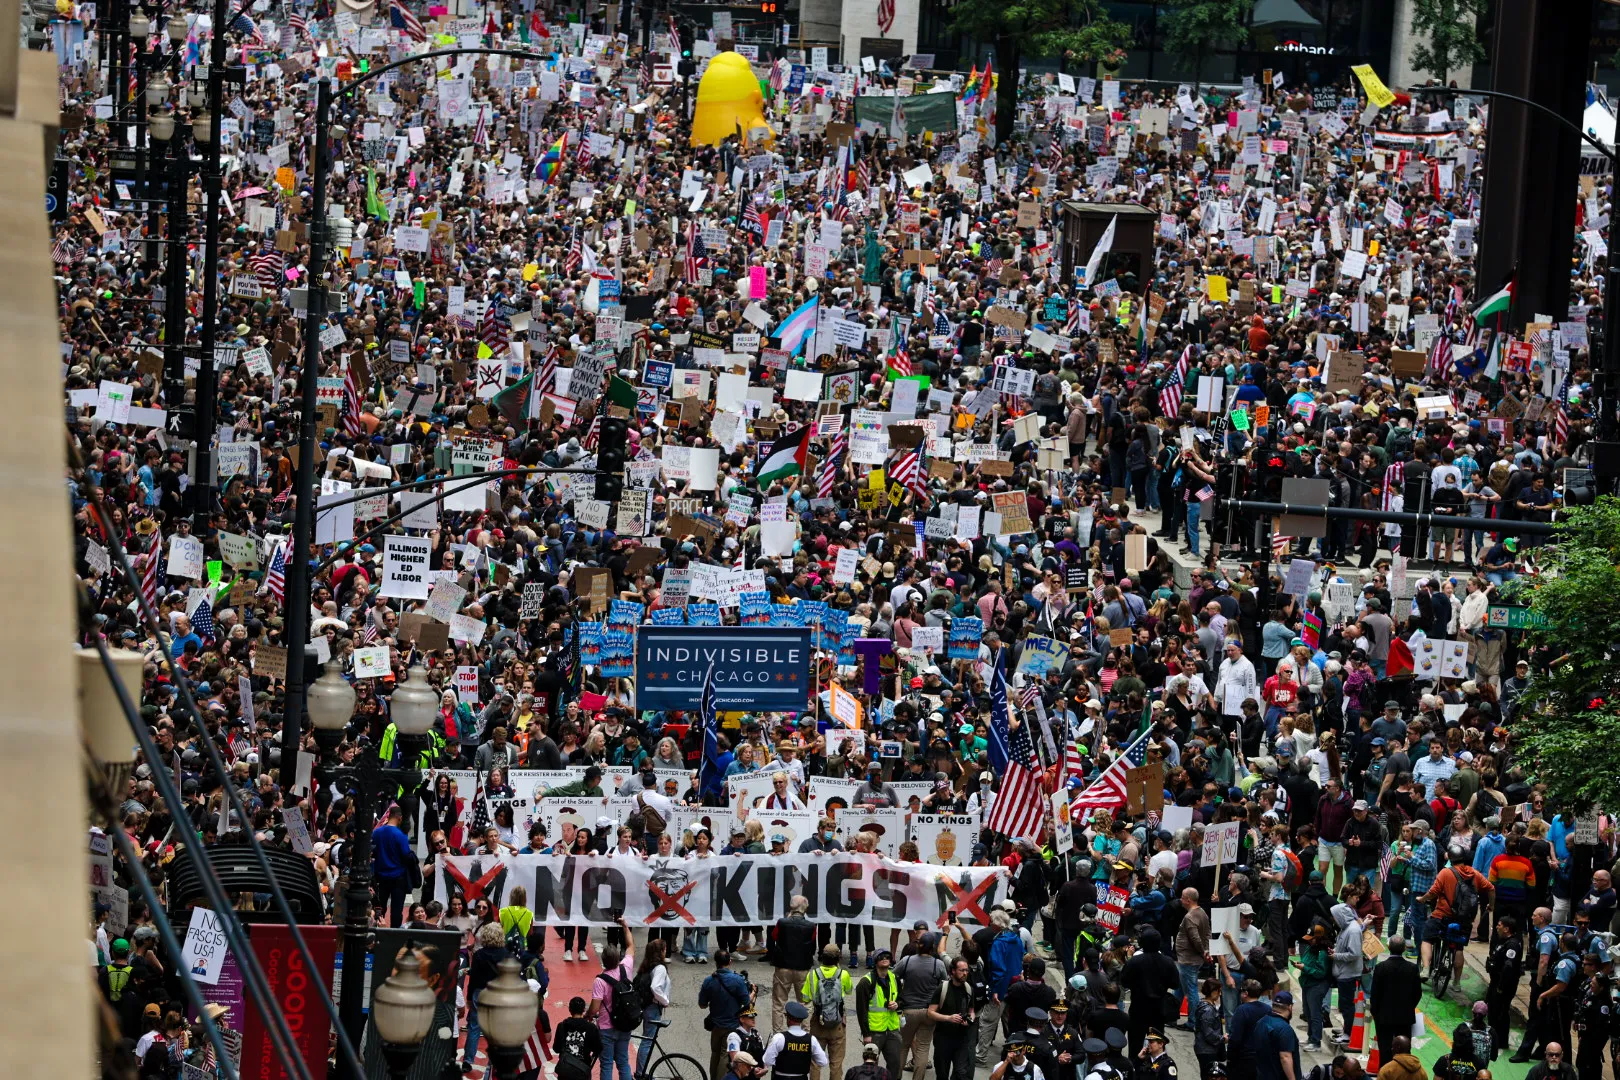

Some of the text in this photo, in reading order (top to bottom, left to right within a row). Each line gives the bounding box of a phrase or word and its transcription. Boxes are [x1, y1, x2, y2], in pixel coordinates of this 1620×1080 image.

[740, 219, 762, 234] AME
[237, 281, 258, 290] YOU'RE
[238, 288, 258, 298] FIRED!
[576, 354, 604, 370] IMPEACH
[656, 366, 670, 374] KINGS
[574, 368, 600, 385] CONVICT
[647, 374, 668, 382] AMERICA
[568, 380, 596, 400] REMOVE
[684, 388, 699, 396] SOS
[220, 454, 242, 463] DISNEY
[994, 492, 1025, 507] END
[586, 502, 600, 512] NO
[669, 499, 702, 517] PEACE
[580, 512, 604, 524] KINGS!
[1002, 518, 1030, 534] NITED
[388, 544, 428, 554] ILLINOIS
[390, 553, 425, 564] HIGHER
[391, 573, 422, 583] LABOR
[715, 572, 741, 587] Imagine
[525, 584, 544, 592] DO YOU
[522, 601, 541, 610] PEOPLE
[1025, 638, 1070, 658] MELT
[647, 648, 800, 664] INDIVISIBLE
[458, 673, 476, 681] STOP
[676, 670, 770, 682] CHCAGO
[459, 685, 478, 694] HIM!
[743, 773, 768, 781] RESISTER
[492, 799, 527, 809] KINGS
[938, 816, 972, 825] KINGS
[1224, 826, 1238, 841] KINGS
[1204, 842, 1236, 862] YES NO
[534, 857, 910, 923] NO KINGS
[200, 911, 224, 932] NO
[1102, 910, 1121, 927] KING
[188, 927, 228, 948] FASCIST
[194, 942, 214, 958] USA
[787, 1042, 810, 1052] POLICE
[1024, 1044, 1035, 1054] ICE
